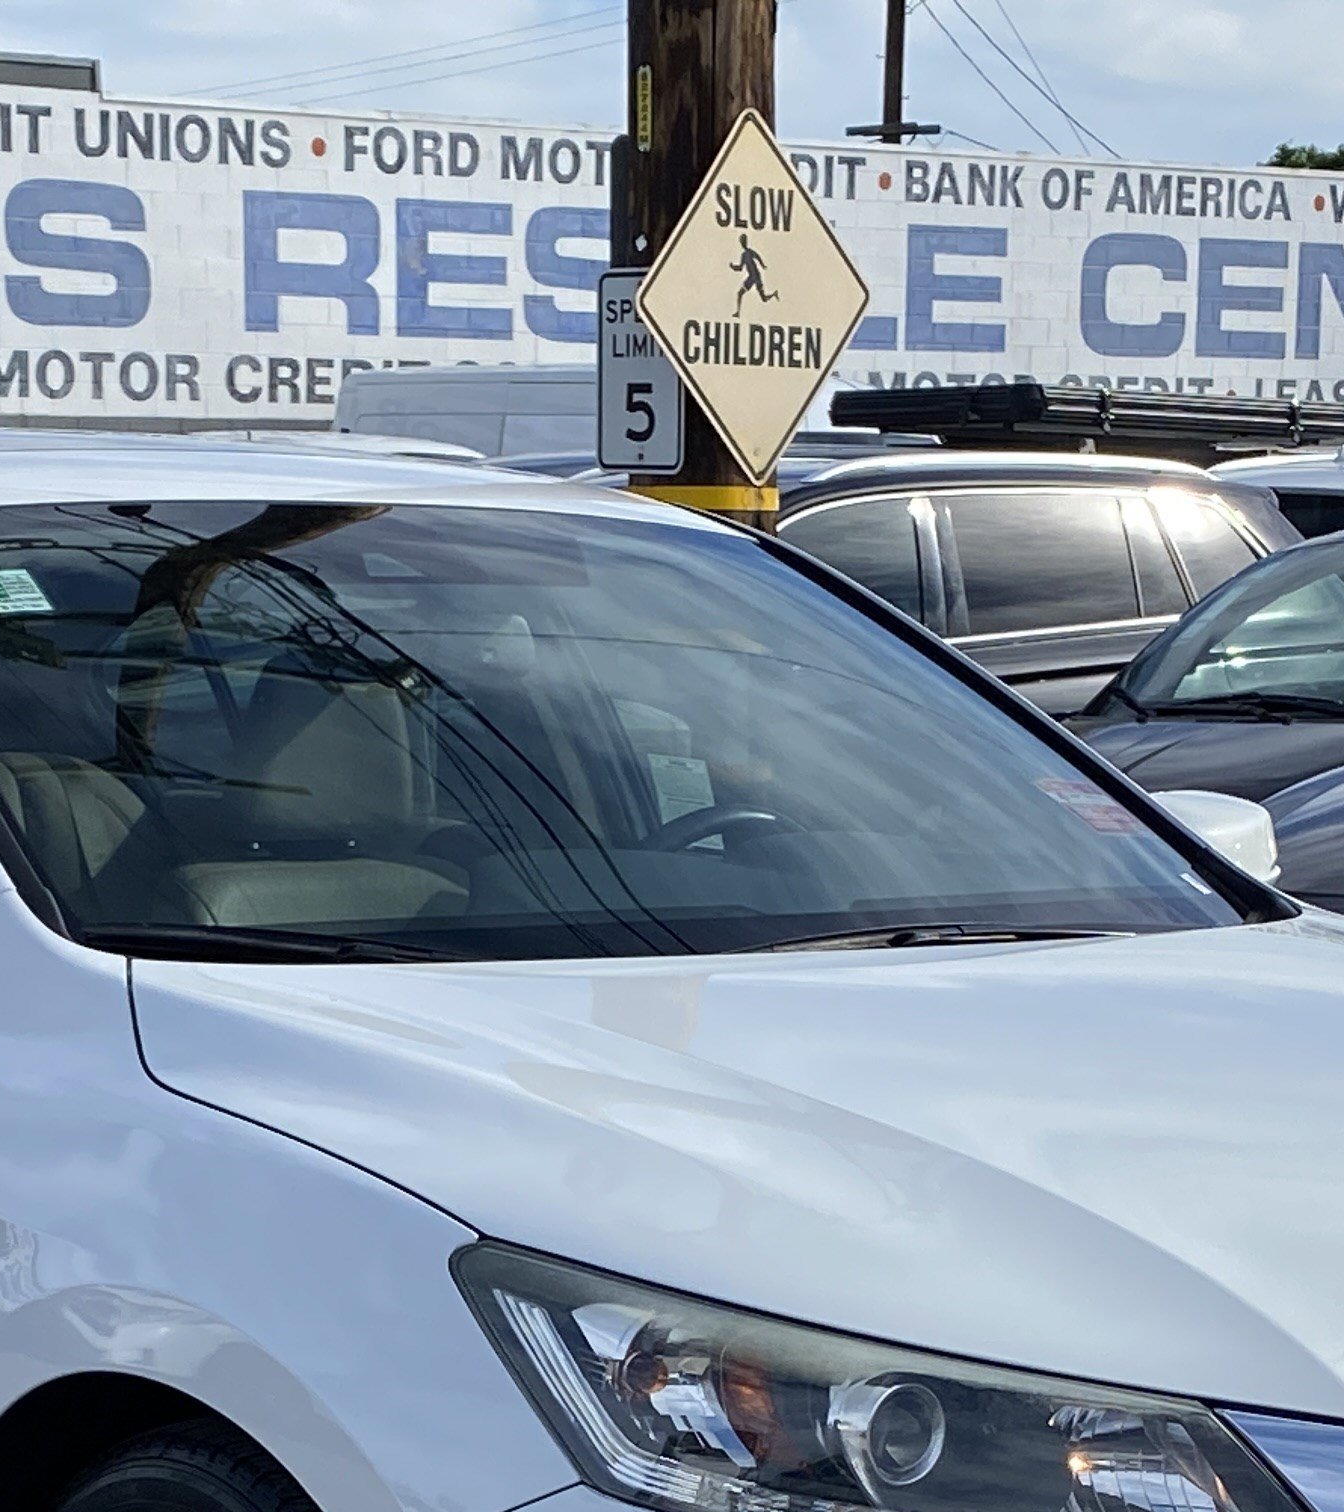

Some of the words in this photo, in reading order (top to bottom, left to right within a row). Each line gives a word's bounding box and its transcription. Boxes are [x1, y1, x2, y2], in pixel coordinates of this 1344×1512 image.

[73, 107, 291, 168] UNIONS
[343, 125, 480, 178] FORD
[501, 136, 611, 186] MOT
[790, 153, 866, 200] DIT
[905, 161, 1023, 208] BANK
[1041, 168, 1093, 211] OF
[1106, 173, 1292, 221] AMERICA
[715, 183, 794, 231] SLOW
[613, 334, 664, 358] LIMI
[684, 320, 821, 369] CHILDREN
[225, 351, 431, 404] CRE
[626, 383, 655, 442] 5
